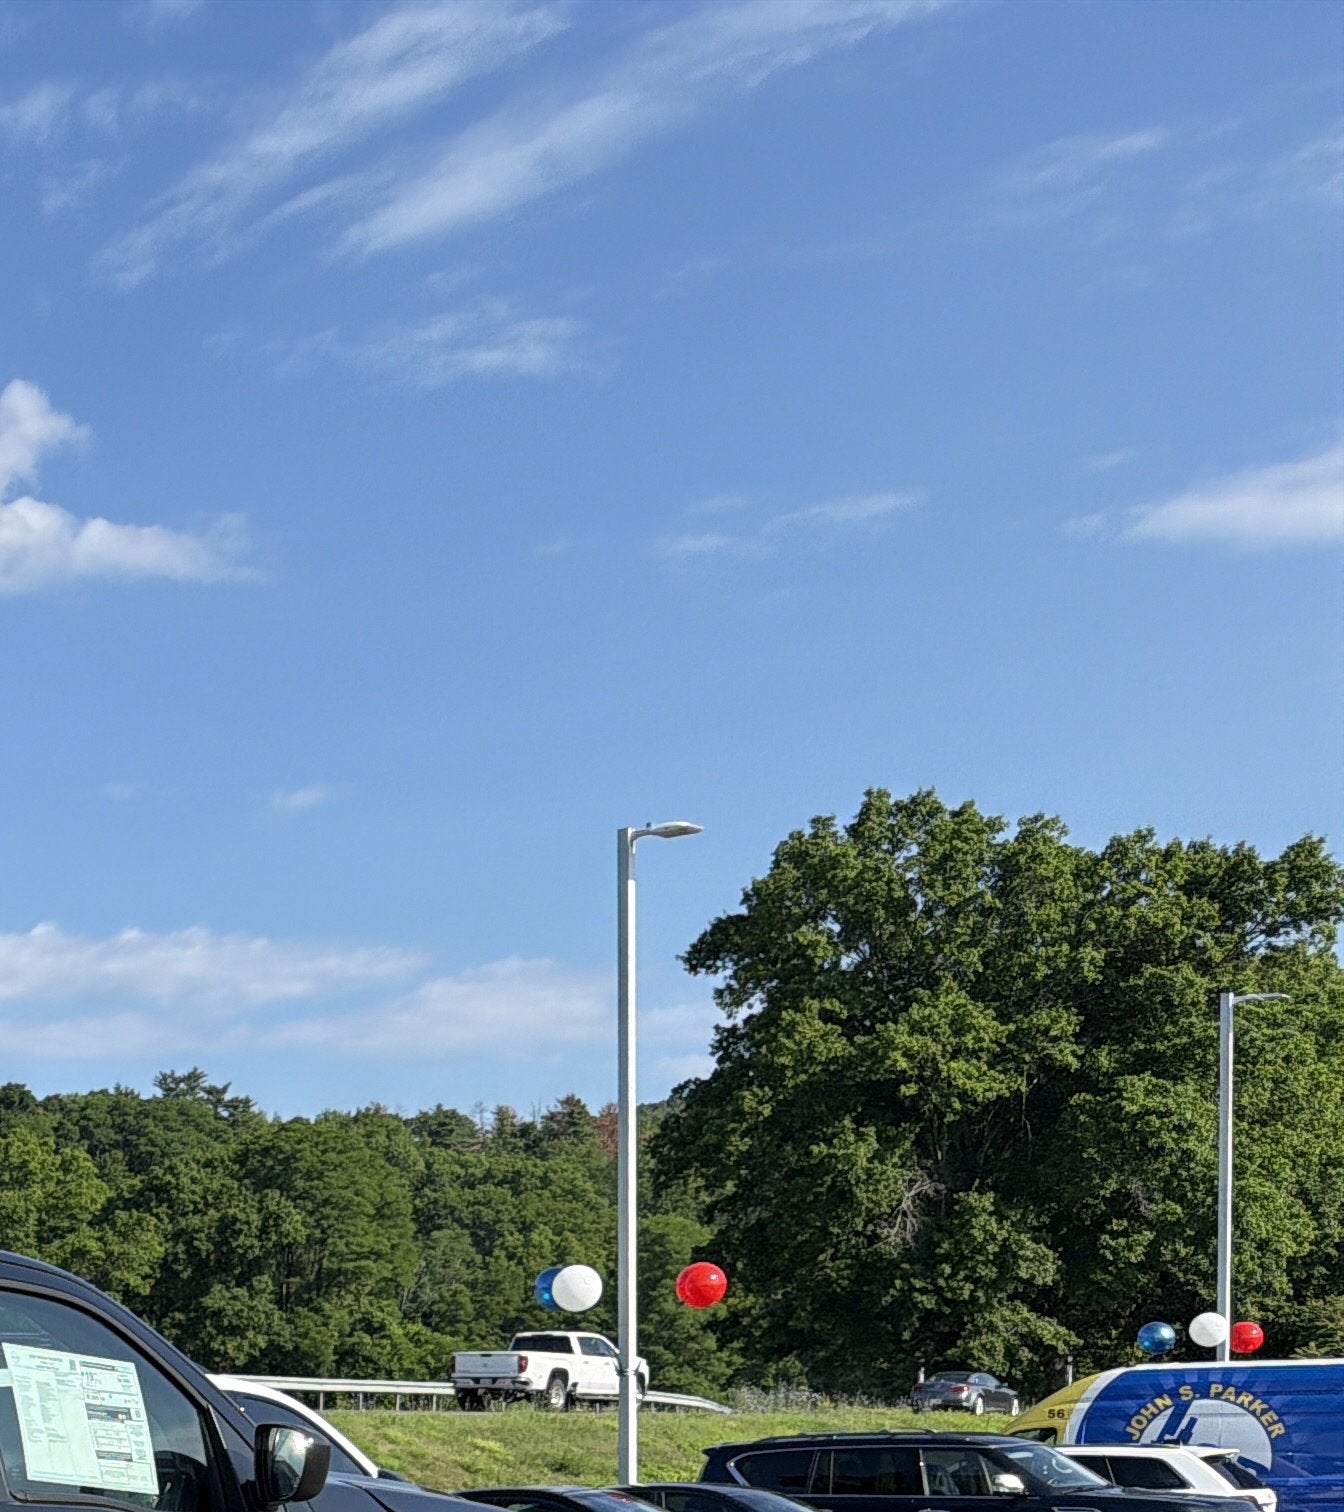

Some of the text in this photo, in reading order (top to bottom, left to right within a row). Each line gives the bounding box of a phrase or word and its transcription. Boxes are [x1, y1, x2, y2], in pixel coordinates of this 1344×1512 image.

[1047, 1408, 1065, 1419] 56
[1125, 1383, 1286, 1441] JOHN S. PARKER
